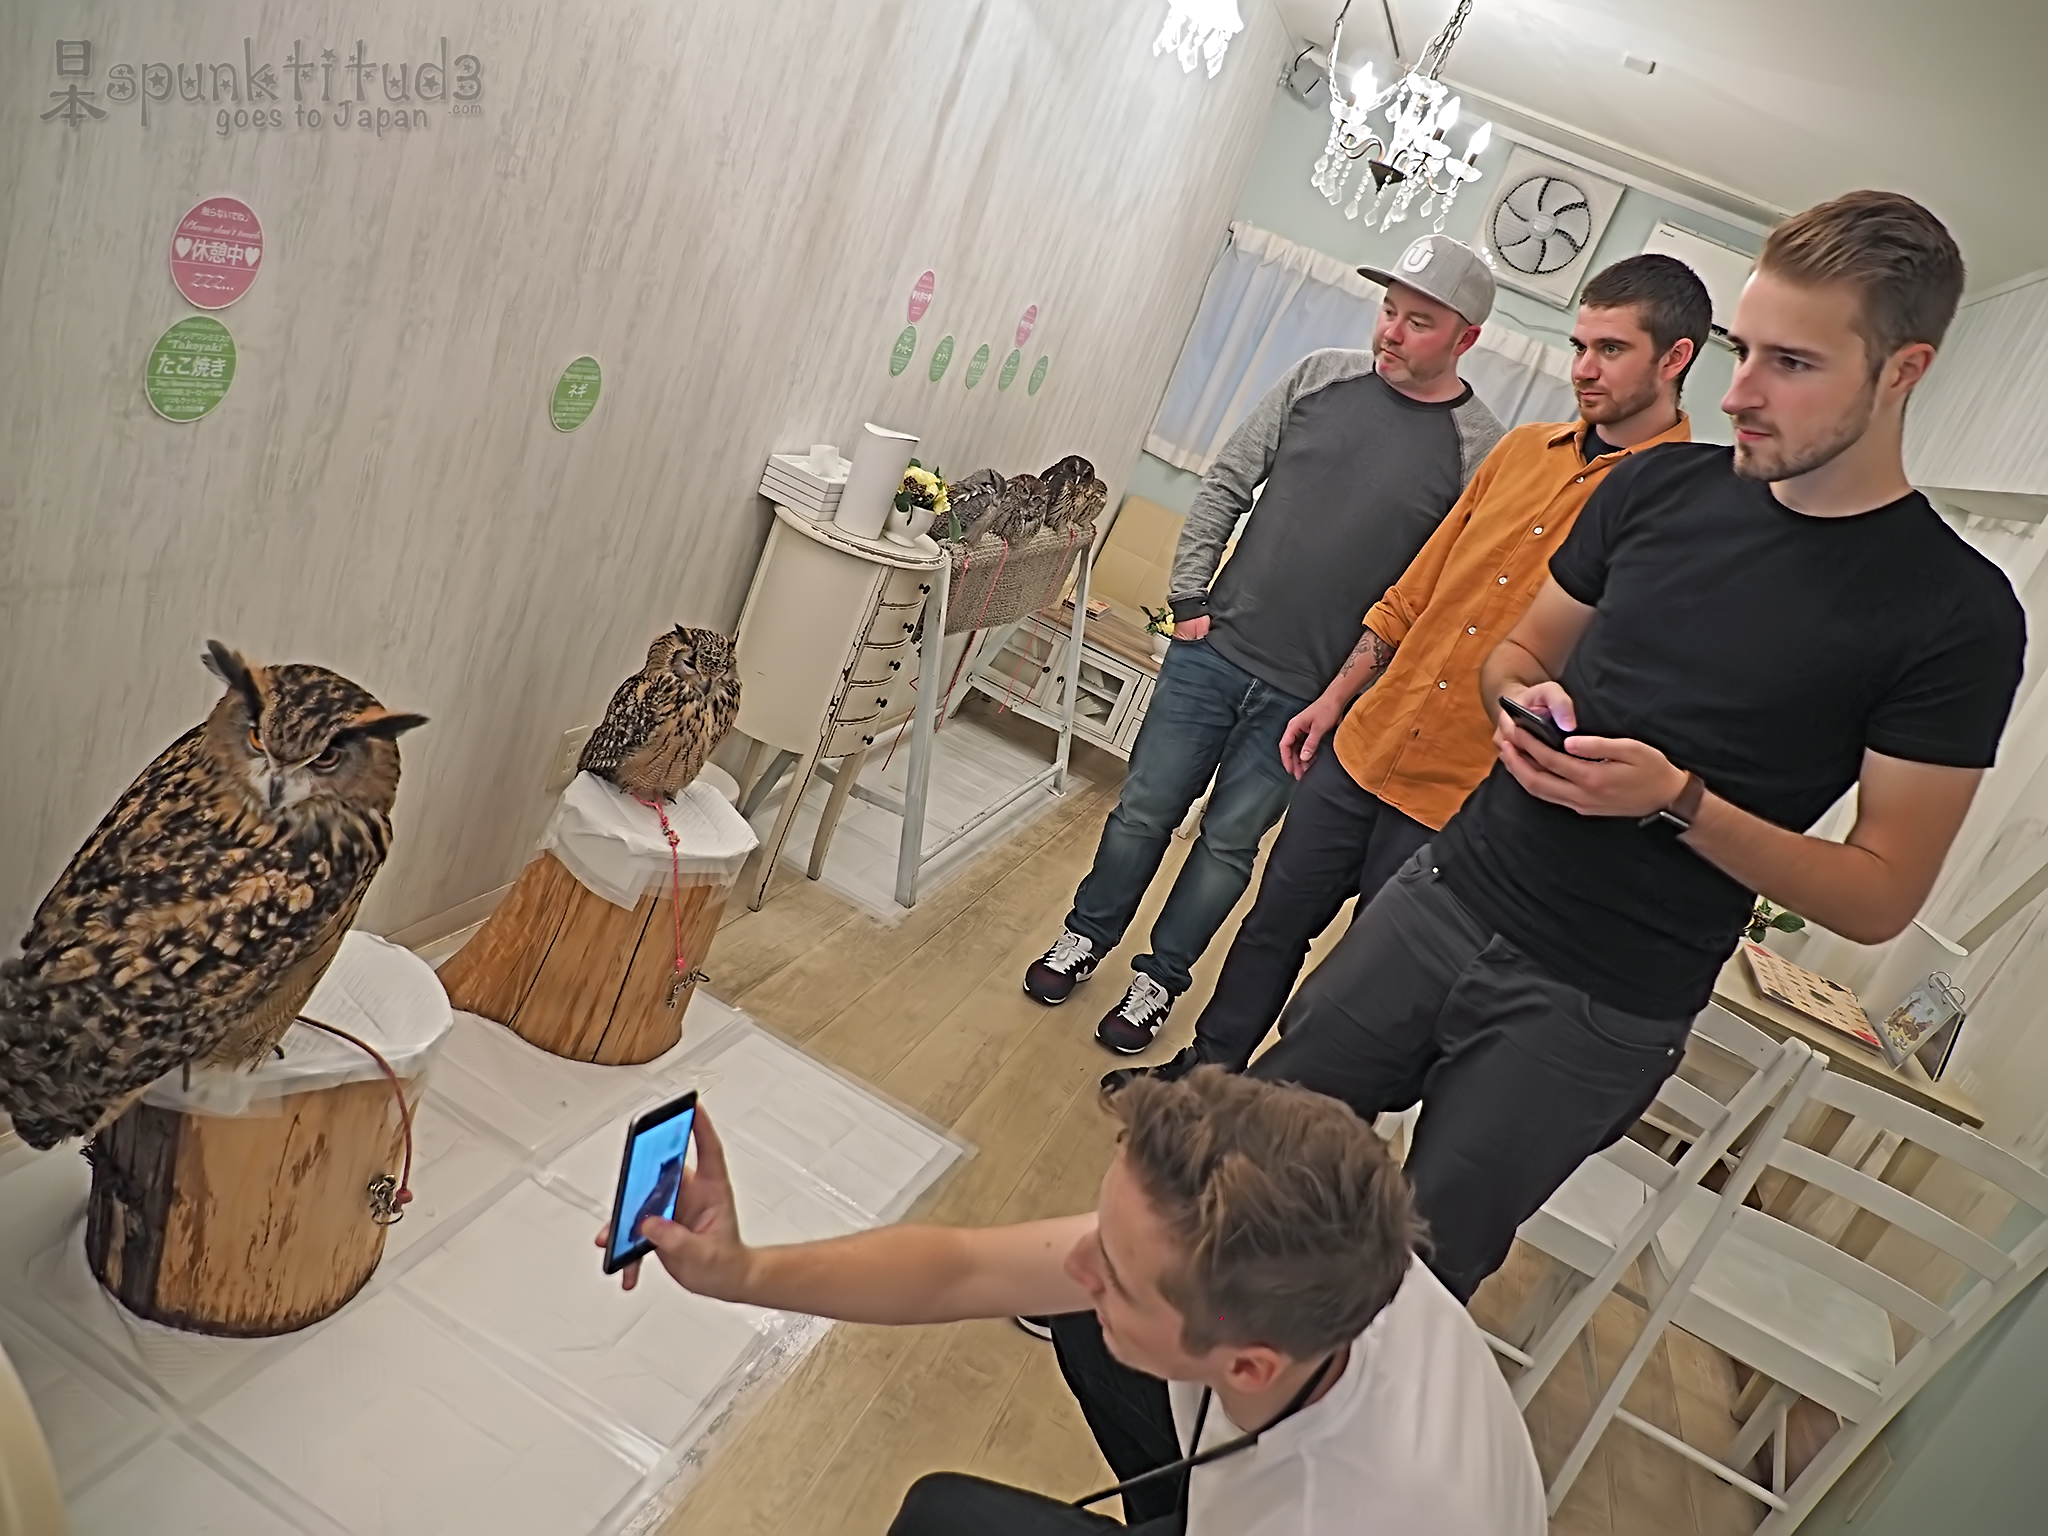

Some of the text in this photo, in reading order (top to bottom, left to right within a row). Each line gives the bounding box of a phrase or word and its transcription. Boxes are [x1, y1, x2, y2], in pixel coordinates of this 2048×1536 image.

[192, 239, 244, 266] 休憩中
[156, 354, 227, 378] たこ焼き
